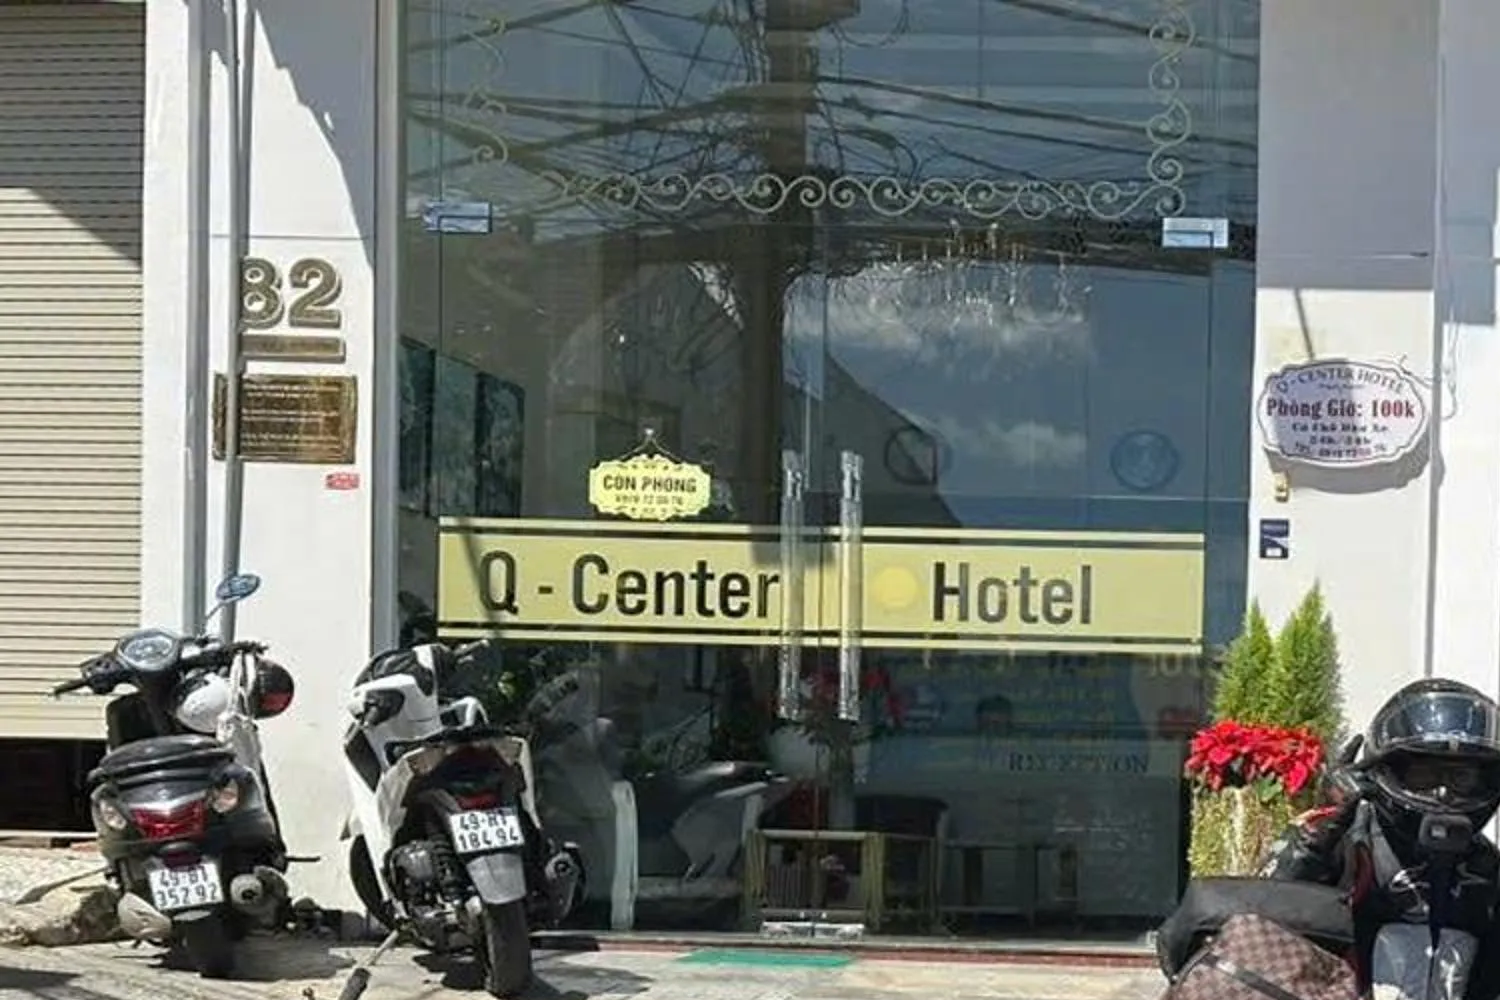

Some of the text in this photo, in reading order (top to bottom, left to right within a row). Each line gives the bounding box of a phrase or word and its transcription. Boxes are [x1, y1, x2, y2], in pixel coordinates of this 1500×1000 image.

[241, 257, 341, 329] 82
[1371, 399, 1415, 418] 100k
[479, 550, 519, 616] Q
[572, 553, 779, 618] Center
[933, 561, 1092, 625] Hotel
